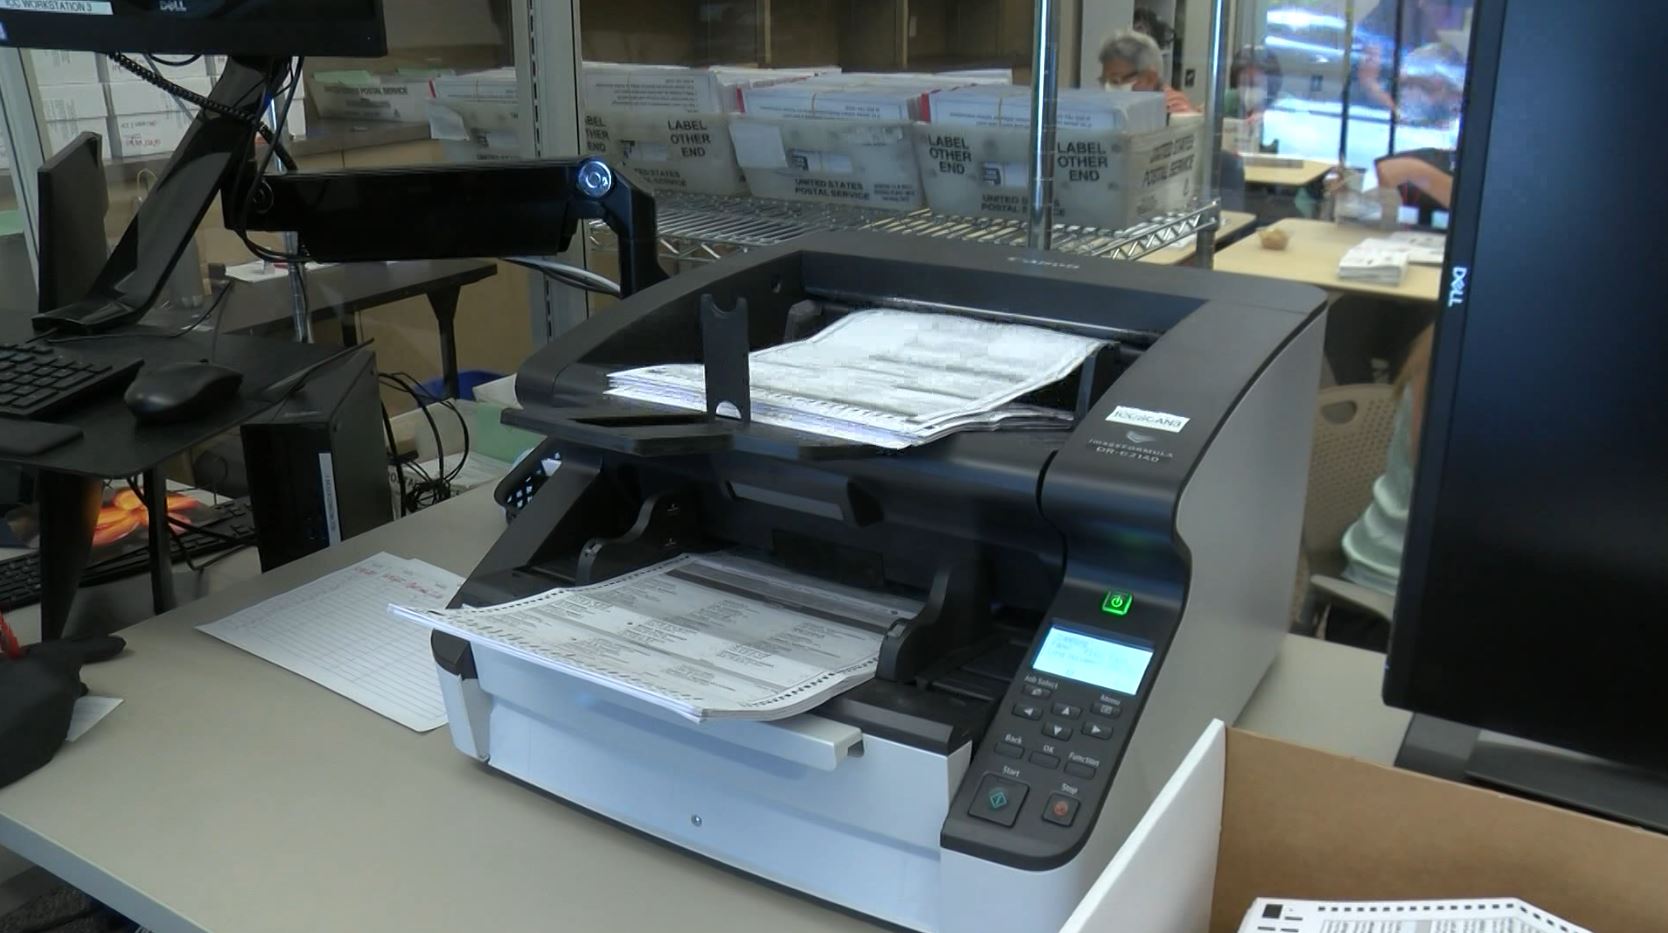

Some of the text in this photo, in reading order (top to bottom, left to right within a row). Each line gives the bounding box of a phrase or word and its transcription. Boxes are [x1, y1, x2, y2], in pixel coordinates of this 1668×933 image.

[160, 1, 187, 12] DELL
[667, 120, 707, 131] LABEL
[670, 134, 711, 145] OTHER
[928, 134, 970, 150] LABEL
[682, 147, 706, 157] END
[1057, 142, 1107, 154] LABEL
[929, 148, 972, 162] OTHER
[1057, 156, 1108, 168] OTHER
[940, 162, 965, 175] END
[1069, 170, 1100, 182] END
[1448, 266, 1468, 308] DELL
[1005, 733, 1022, 745] Back
[1043, 744, 1055, 754] OK
[1068, 751, 1100, 767] Function
[1003, 765, 1021, 778] Start
[1061, 782, 1079, 795] Stop
